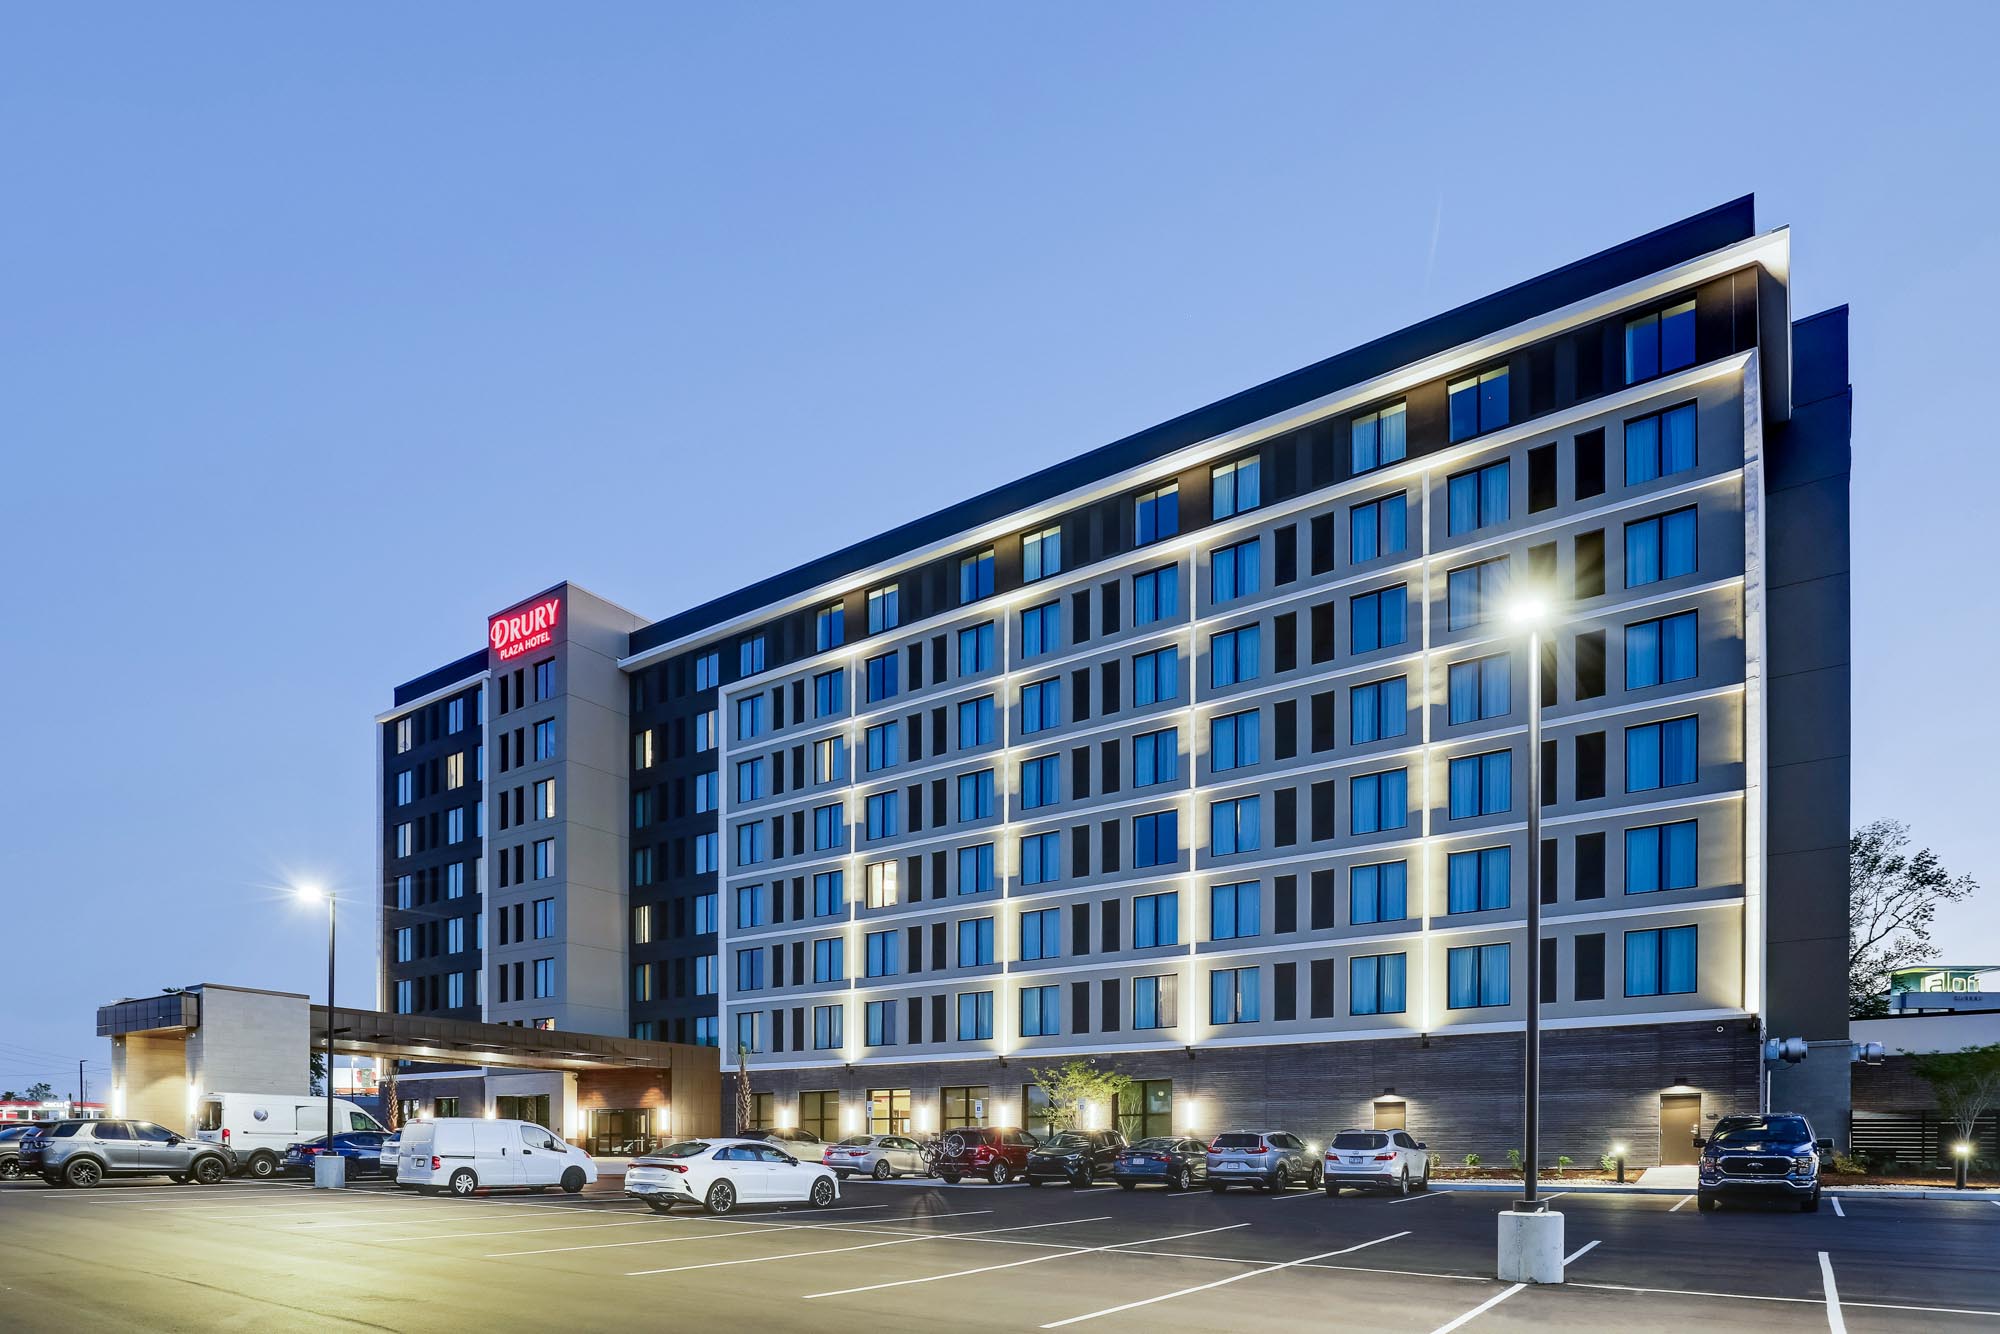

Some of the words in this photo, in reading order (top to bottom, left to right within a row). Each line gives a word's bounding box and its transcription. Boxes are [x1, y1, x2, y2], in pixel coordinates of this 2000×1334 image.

[490, 599, 559, 649] DRURY
[500, 642, 525, 660] PLAZA
[525, 631, 550, 650] HOTEL
